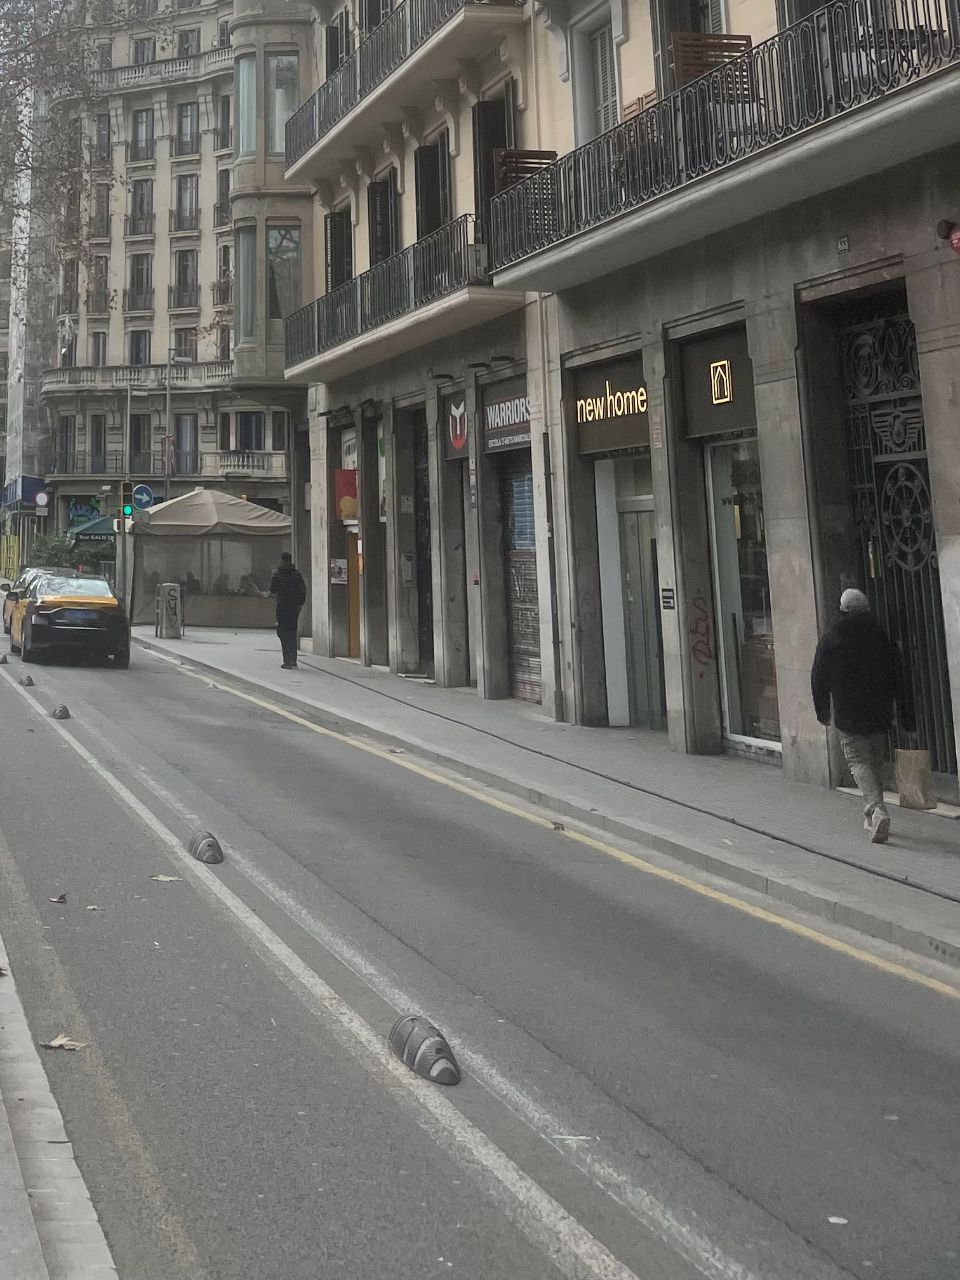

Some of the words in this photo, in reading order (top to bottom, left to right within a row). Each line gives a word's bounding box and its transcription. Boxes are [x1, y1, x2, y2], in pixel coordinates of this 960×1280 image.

[487, 397, 531, 429] WARRIORS
[576, 397, 604, 423] new
[605, 380, 647, 415] home
